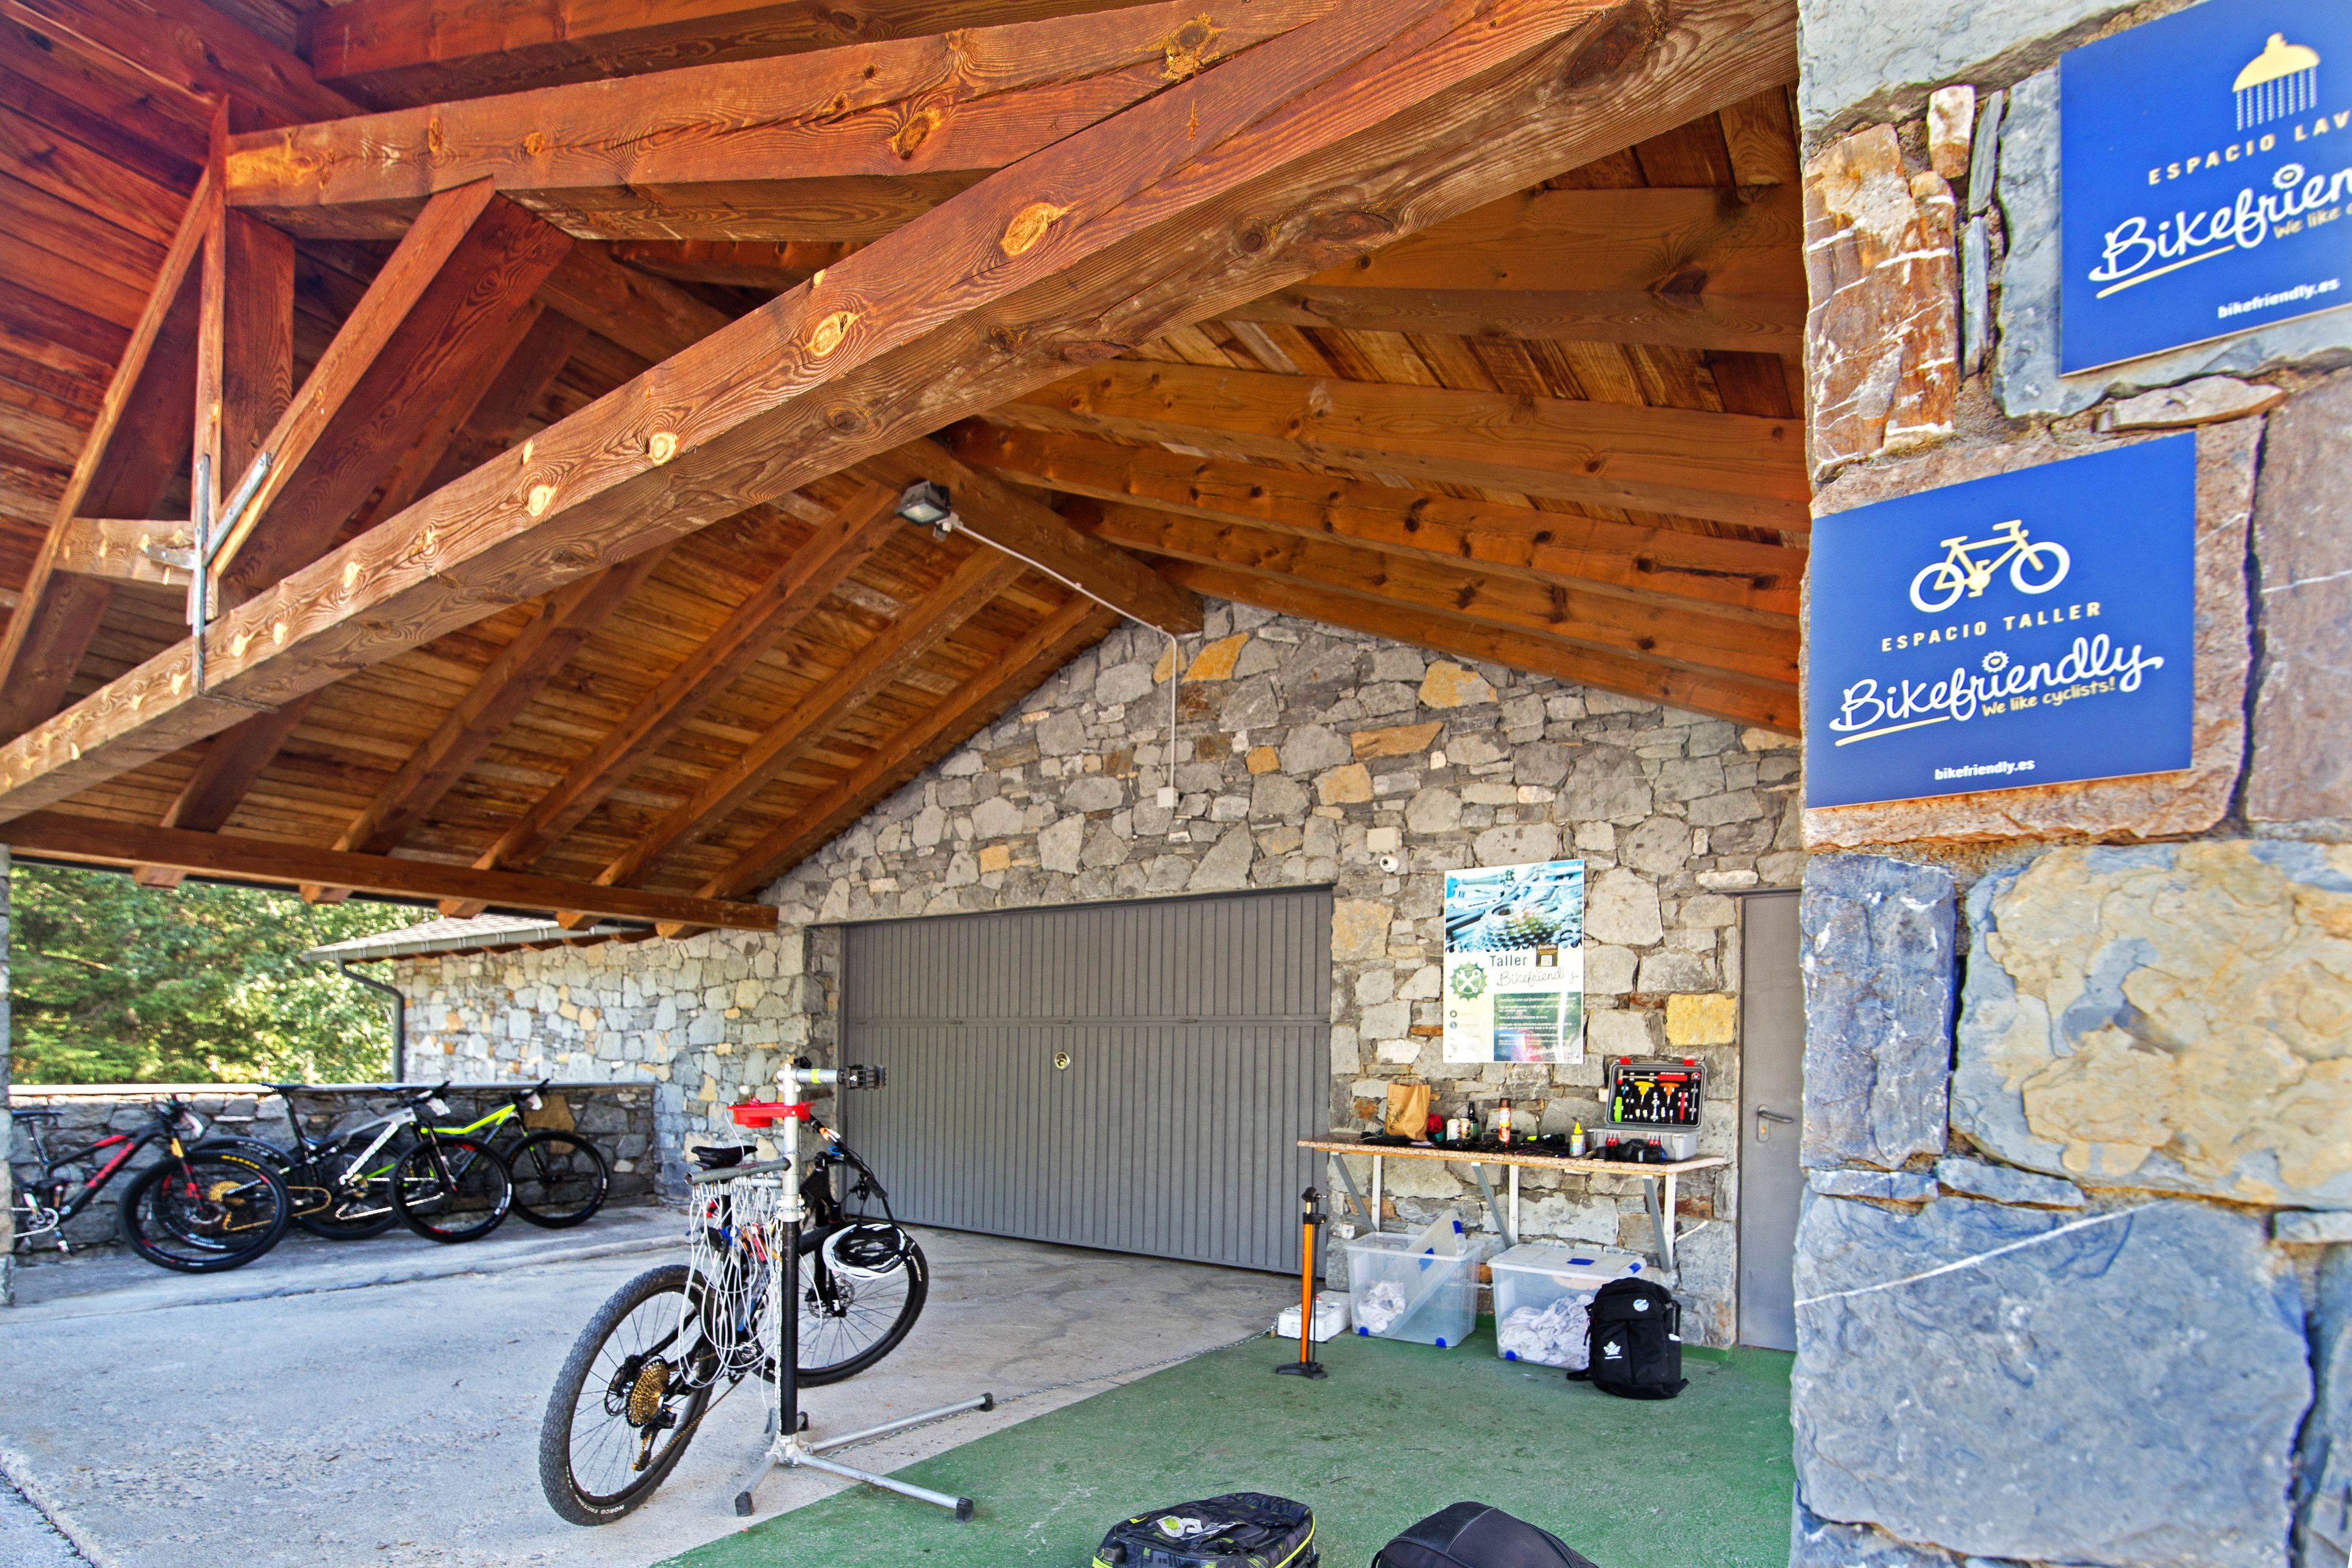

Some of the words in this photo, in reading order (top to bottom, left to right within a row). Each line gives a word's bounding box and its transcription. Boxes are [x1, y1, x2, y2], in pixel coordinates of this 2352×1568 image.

[2148, 134, 2276, 186] ESPACIO
[2294, 110, 2351, 142] LAV
[2273, 219, 2304, 239] We
[2307, 206, 2341, 228] like
[2217, 278, 2341, 318] bikefriendly.es
[1882, 621, 1987, 652] ESPACIO
[2003, 601, 2101, 631] TALLER
[1829, 633, 2165, 731] Bikefriendly
[1981, 701, 2006, 717] We
[2010, 696, 2038, 711] like
[2041, 676, 2116, 706] cyclists!
[1934, 760, 2035, 780] bikefriendly.es
[1490, 955, 1527, 967] Taller
